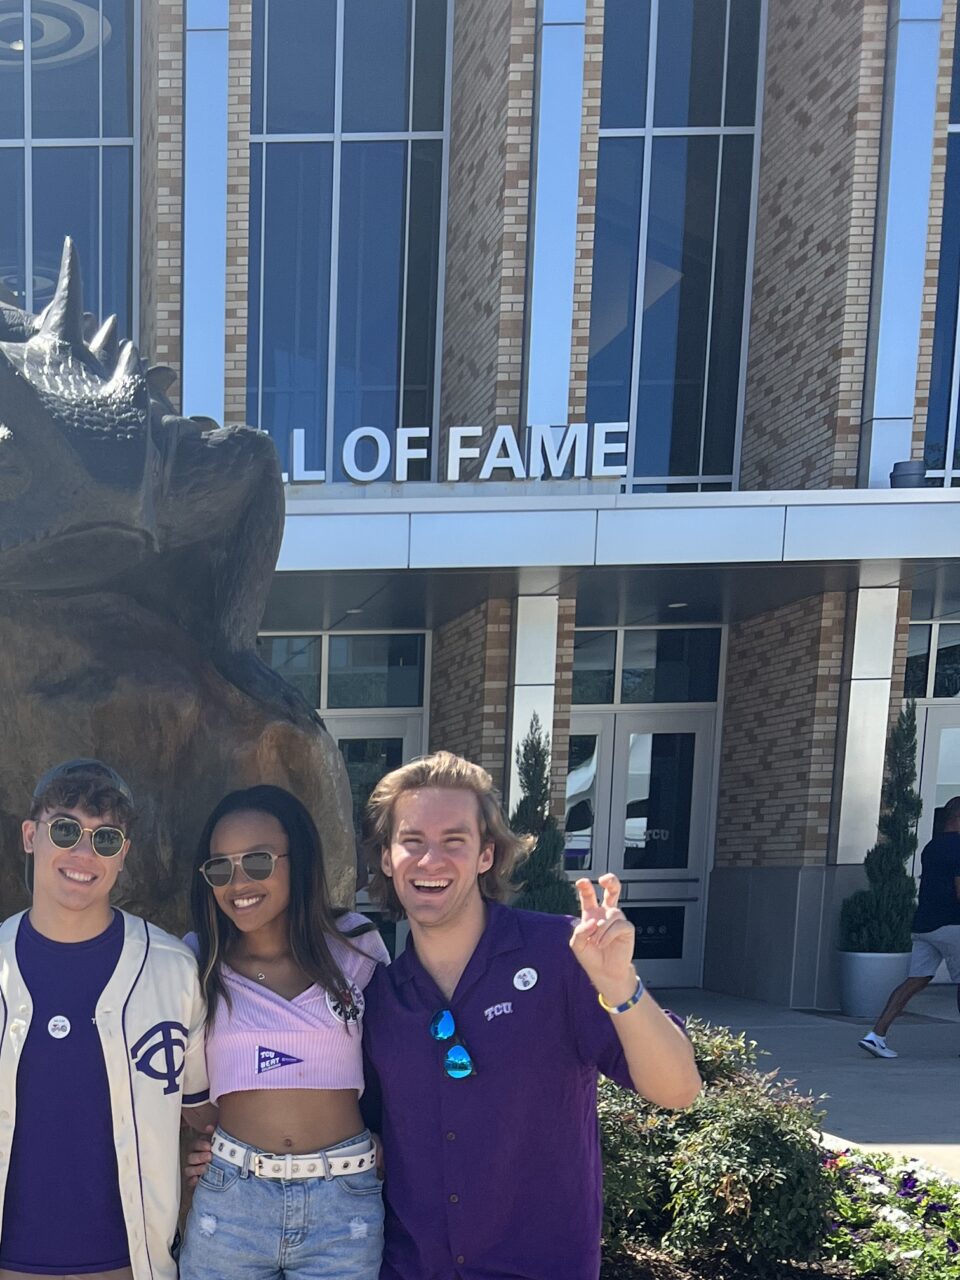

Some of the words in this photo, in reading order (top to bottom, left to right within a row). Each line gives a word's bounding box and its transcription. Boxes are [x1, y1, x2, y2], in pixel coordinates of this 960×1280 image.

[342, 426, 430, 482] OF
[448, 422, 629, 481] FAME
[484, 1002, 513, 1021] TCU
[260, 1051, 275, 1059] TCU
[260, 1057, 280, 1068] BEAT
